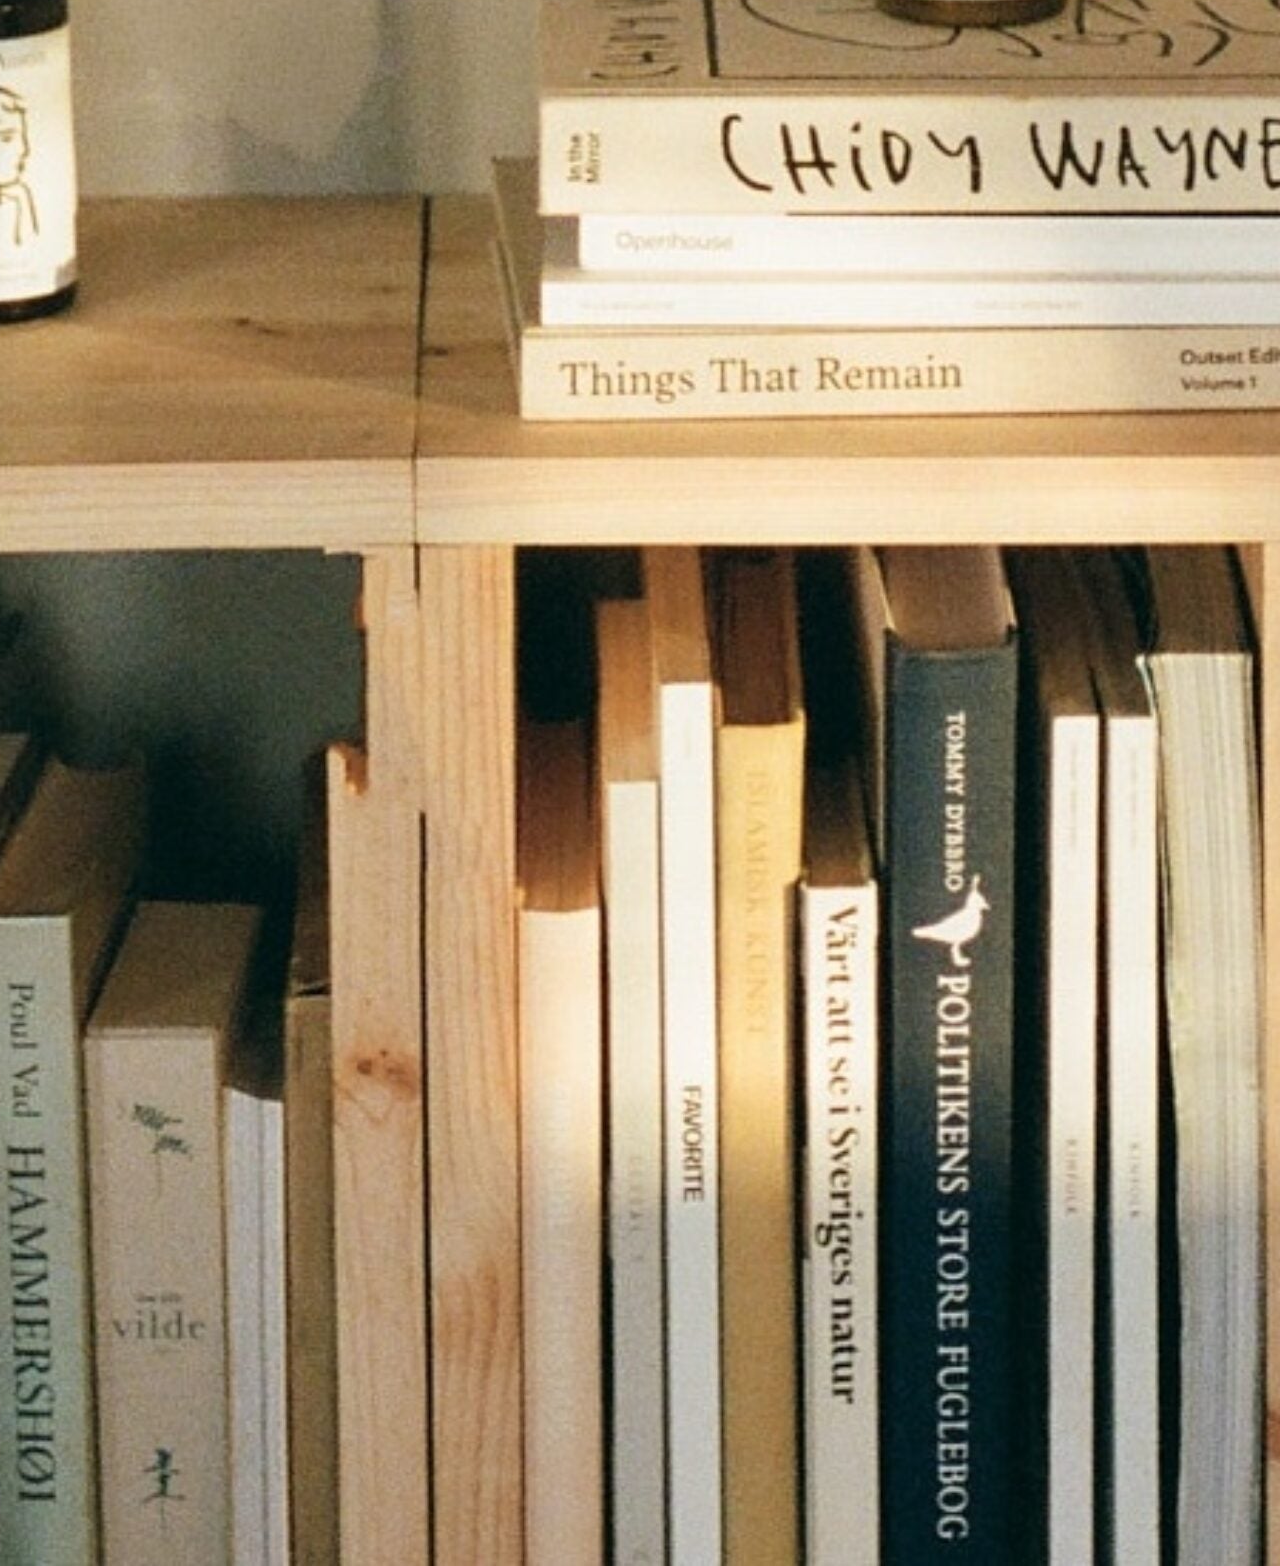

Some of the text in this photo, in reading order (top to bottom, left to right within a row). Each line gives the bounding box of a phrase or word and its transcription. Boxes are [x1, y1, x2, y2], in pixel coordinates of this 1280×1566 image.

[615, 230, 735, 253] Openhouse
[558, 352, 964, 397] Things That Remain
[1179, 345, 1241, 365] Outset
[1179, 375, 1245, 392] Volume
[943, 710, 967, 892] TOMMY DYBBRO
[682, 1085, 705, 1202] FAVORITE
[815, 905, 865, 1405] Värt att se i Sveriges natur
[7, 982, 58, 1504] Poul Vad HAMMERSHØI
[936, 973, 970, 1540] POLITIKENS STORE FUGLEBOG
[111, 1308, 207, 1341] vilde
